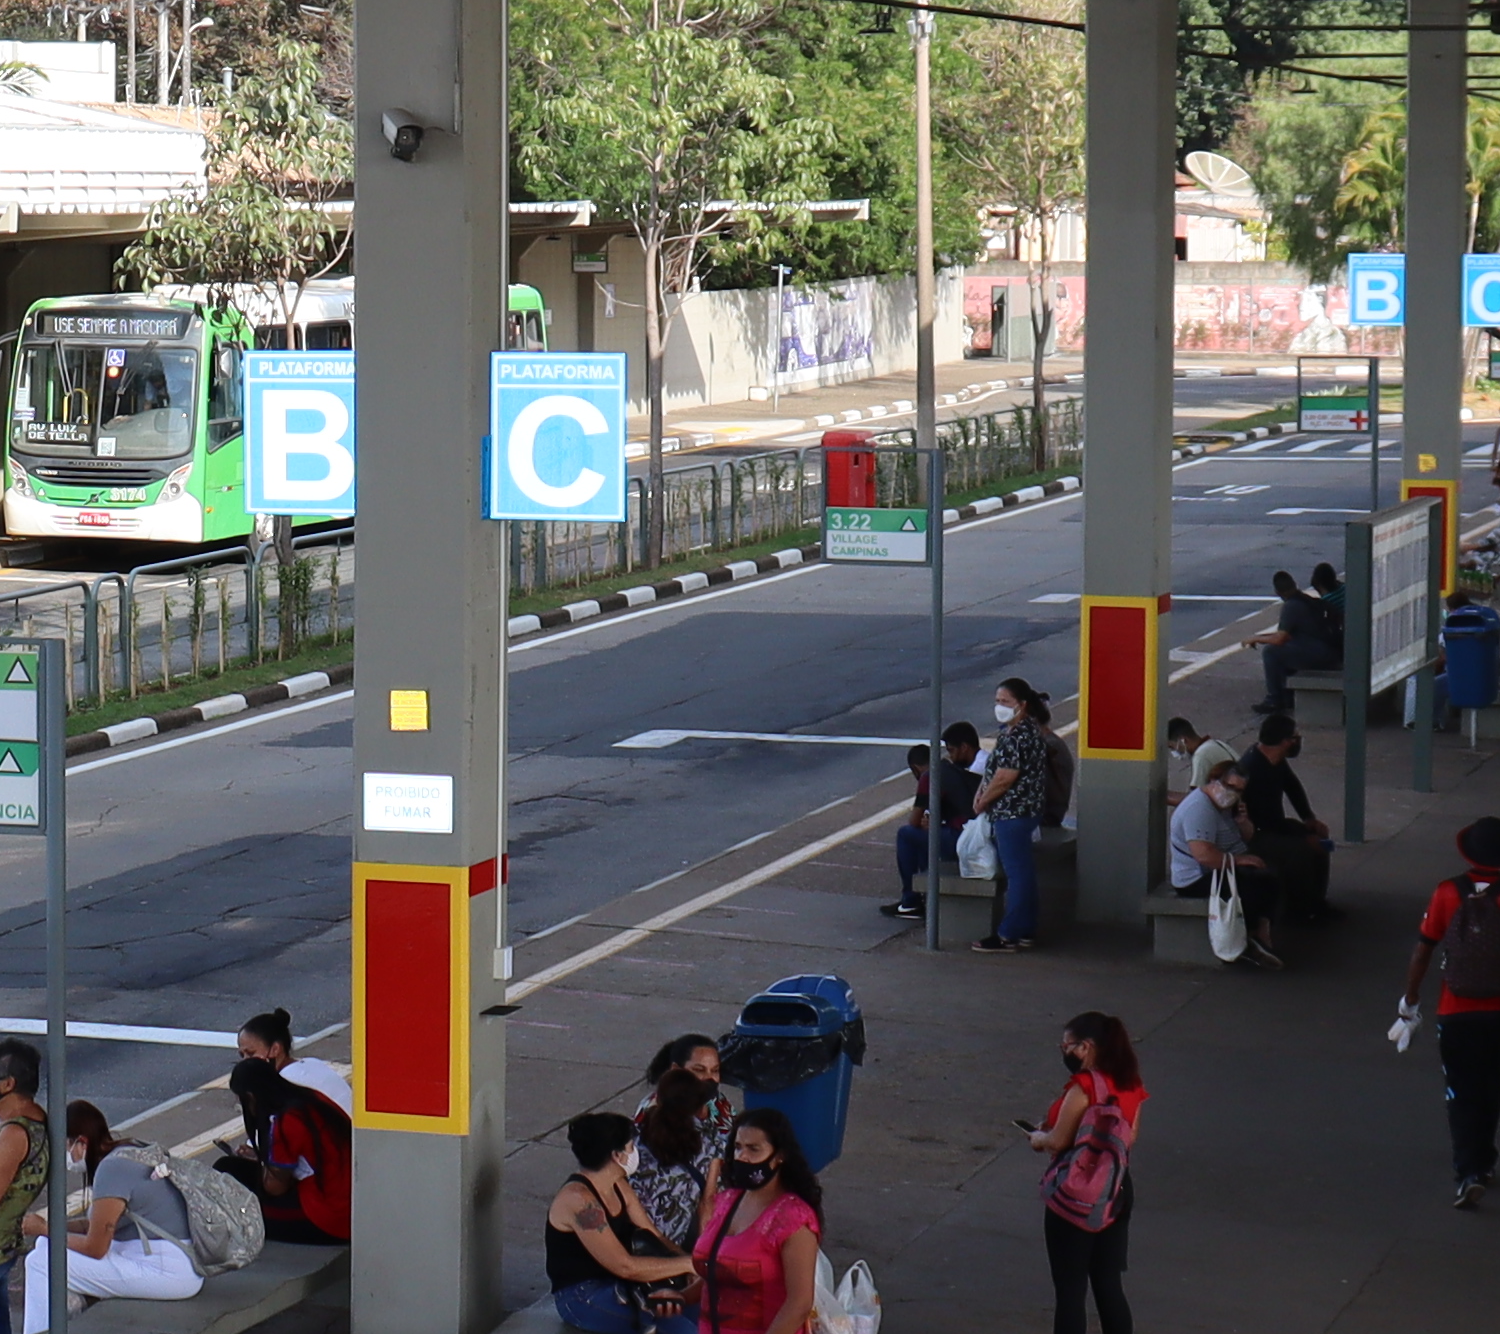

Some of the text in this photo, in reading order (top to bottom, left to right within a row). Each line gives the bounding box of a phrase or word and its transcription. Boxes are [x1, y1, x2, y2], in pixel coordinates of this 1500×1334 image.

[1356, 270, 1401, 320] B
[54, 317, 75, 333] USE
[77, 317, 118, 335] SEMPRE
[120, 319, 128, 335] A
[258, 361, 356, 377] PLATAFORMA
[500, 364, 615, 380] PLATAFORMA
[50, 423, 77, 433] LUIZ
[28, 431, 89, 443] DE TELLA
[262, 389, 355, 501] B
[507, 394, 610, 508] C
[831, 513, 872, 531] 3.22
[831, 533, 878, 545] VILLAGE
[831, 546, 889, 557] CAMPINAS
[375, 786, 441, 799] PROIBIDO
[384, 806, 432, 818] FUMAR
